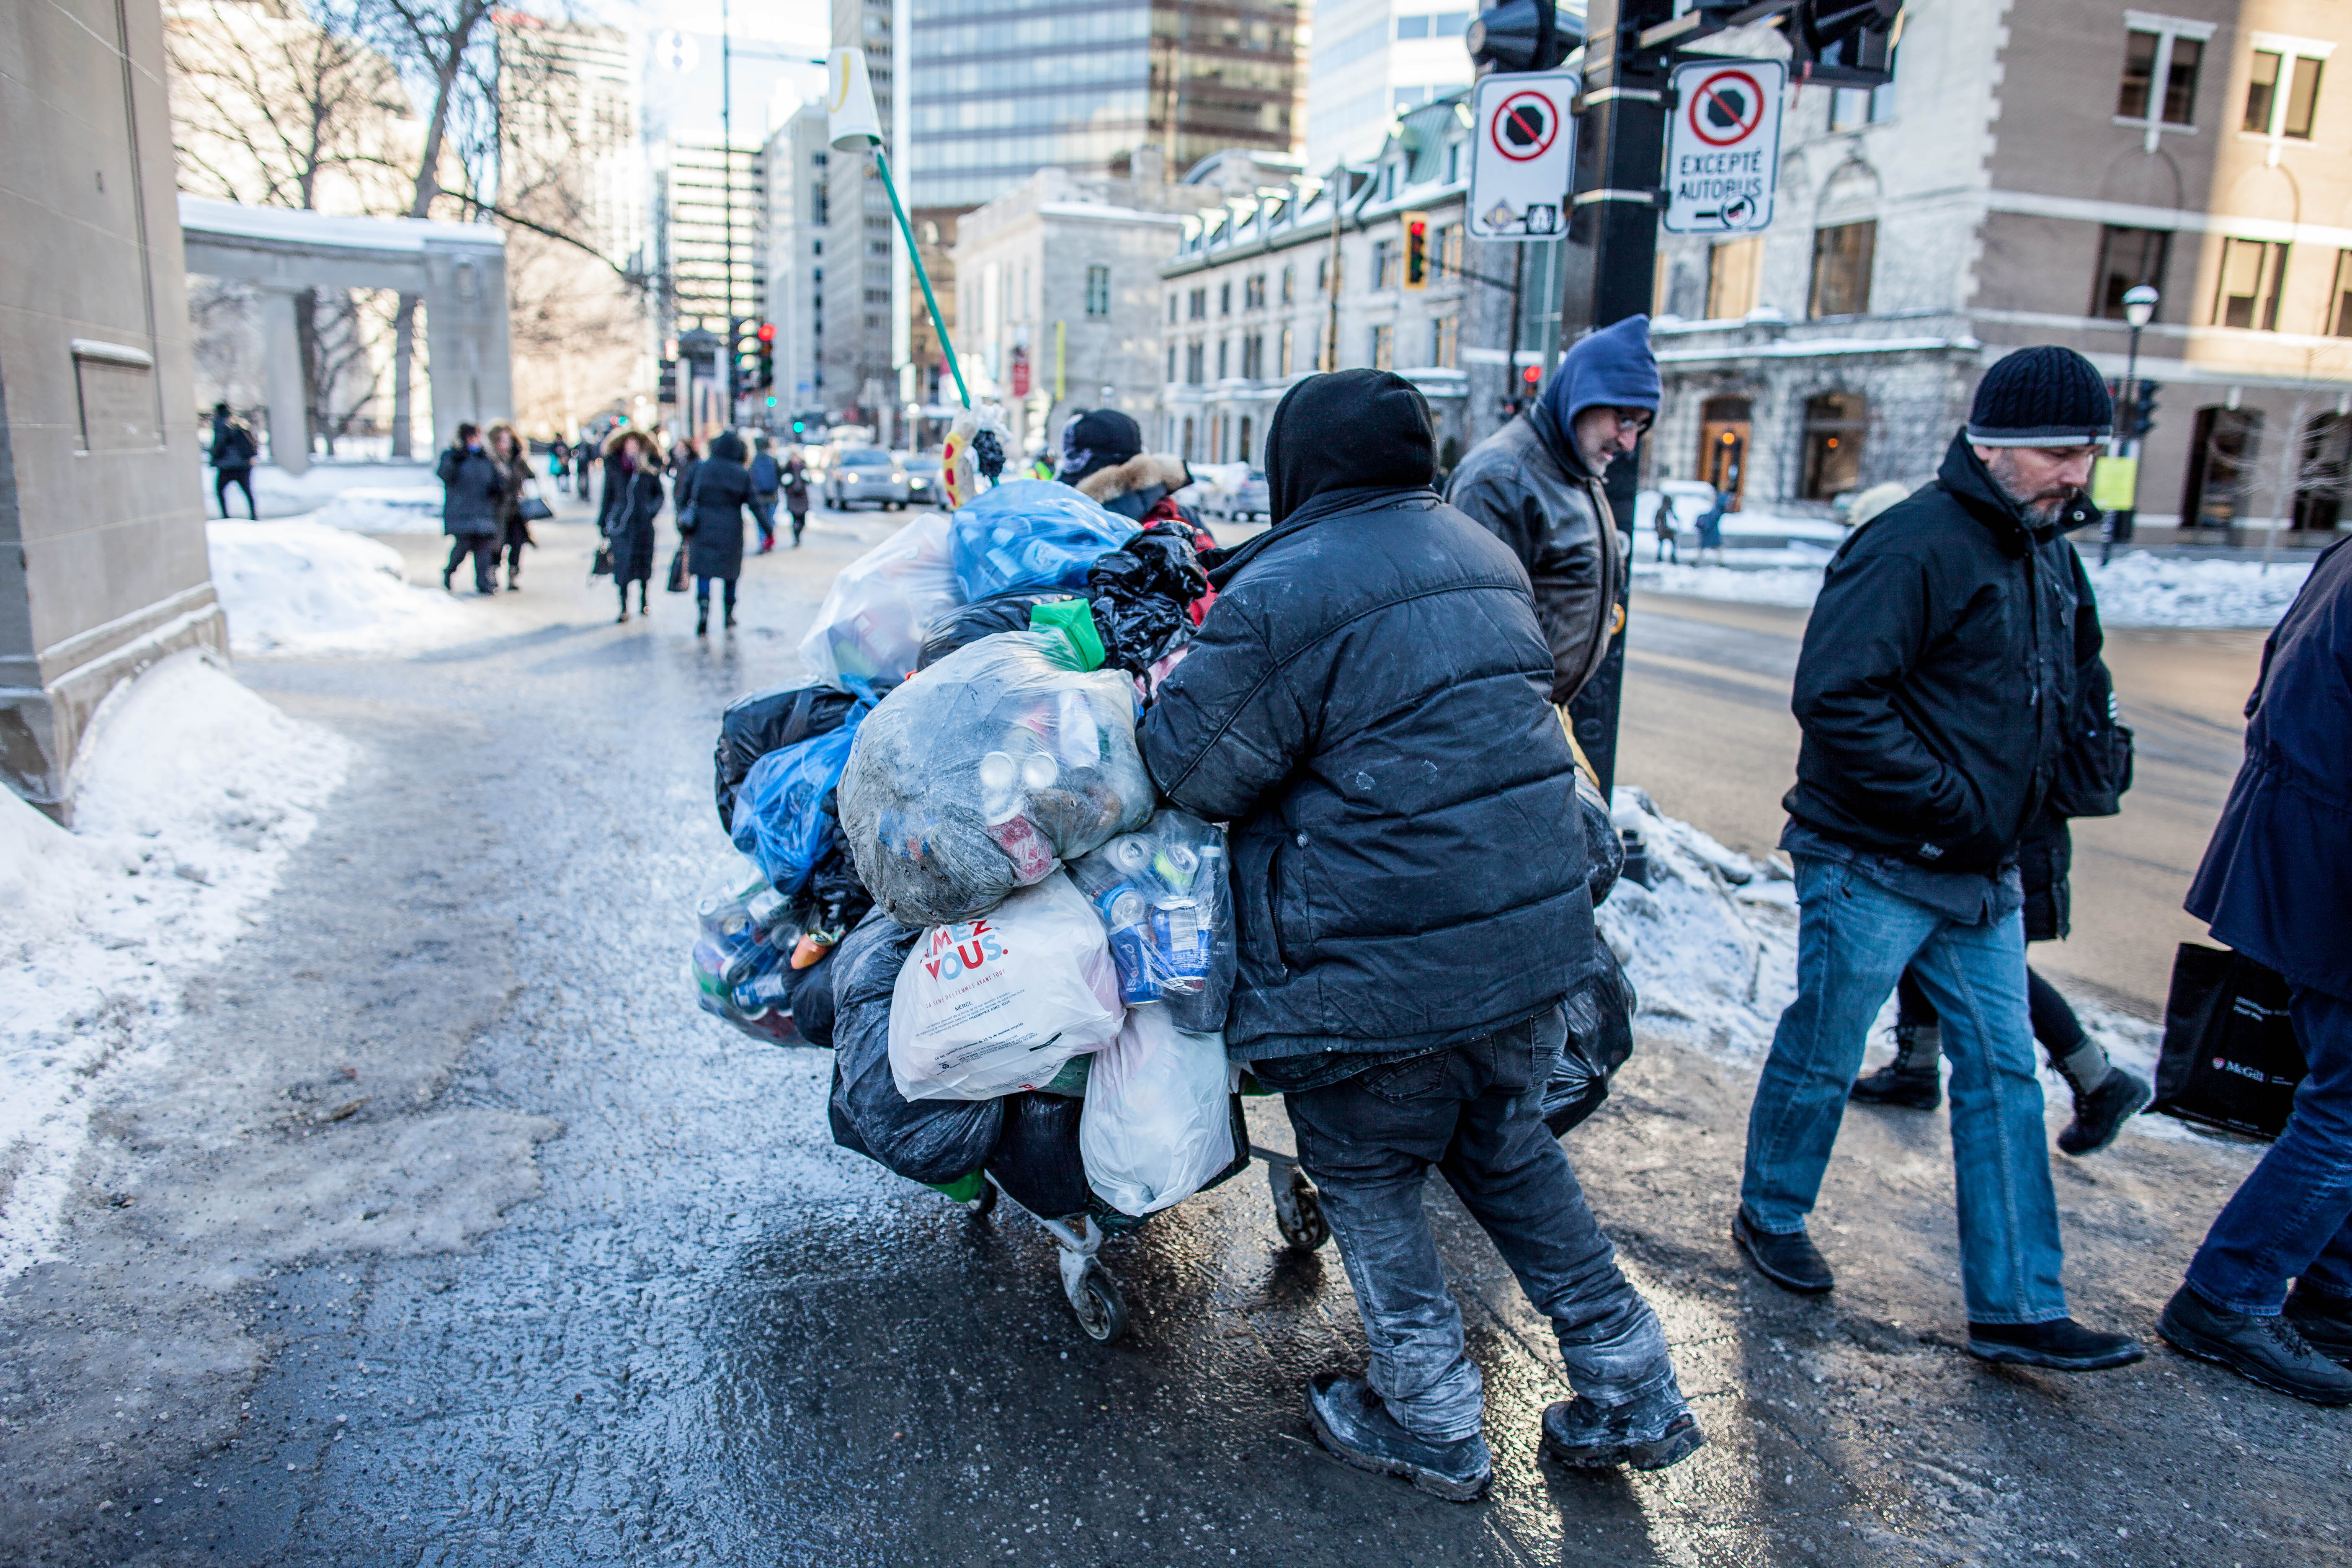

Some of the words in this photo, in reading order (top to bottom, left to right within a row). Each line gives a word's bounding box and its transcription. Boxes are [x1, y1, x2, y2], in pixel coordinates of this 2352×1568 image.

[1680, 147, 1761, 175] EXCEPTÉ
[1676, 178, 1762, 199] AUTOBUS
[925, 934, 1008, 983] VOUS.
[955, 983, 975, 995] FEMMES
[977, 975, 991, 986] AVANT
[993, 968, 1005, 978] TOUT
[955, 1001, 973, 1011] MERCI.
[969, 1009, 990, 1020] PHARMAPRIX
[2225, 1060, 2265, 1083] McGill
